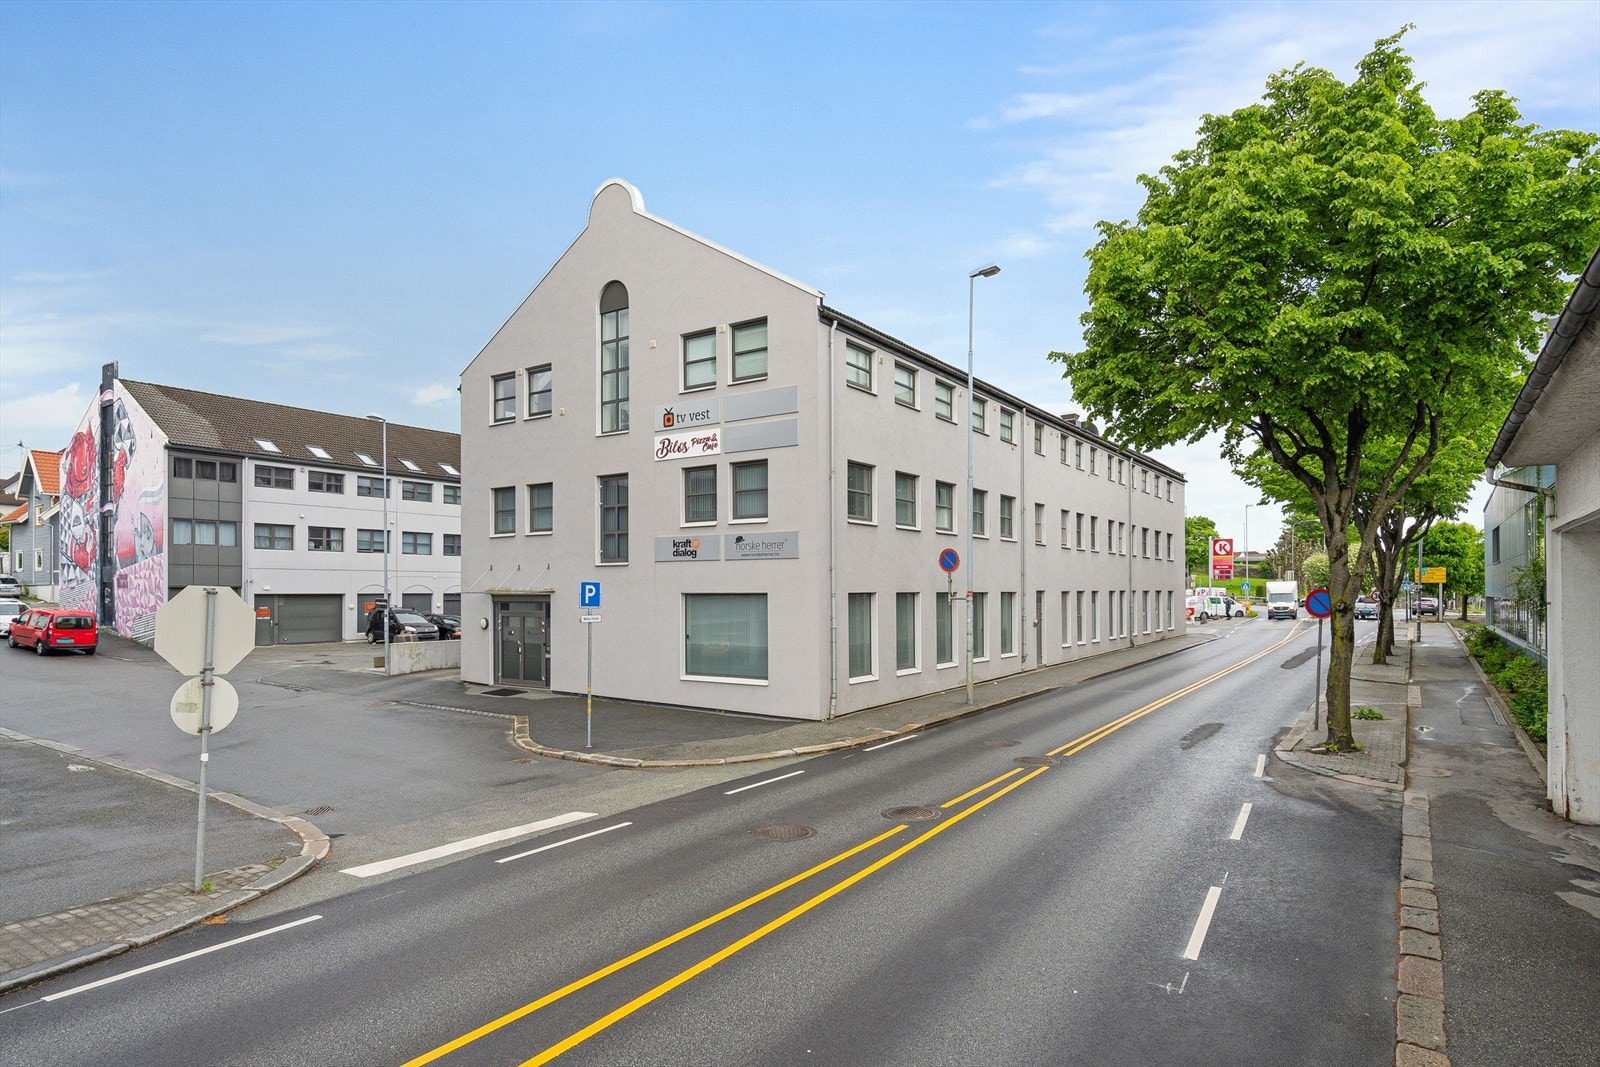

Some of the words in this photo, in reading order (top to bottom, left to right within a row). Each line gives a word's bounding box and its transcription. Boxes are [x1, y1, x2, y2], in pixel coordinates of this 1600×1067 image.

[676, 413, 686, 423] tv
[689, 409, 711, 422] vest
[672, 538, 692, 549] kraft
[735, 541, 761, 551] norske
[761, 540, 785, 550] herrer
[672, 549, 697, 559] dialog
[585, 584, 596, 604] P
